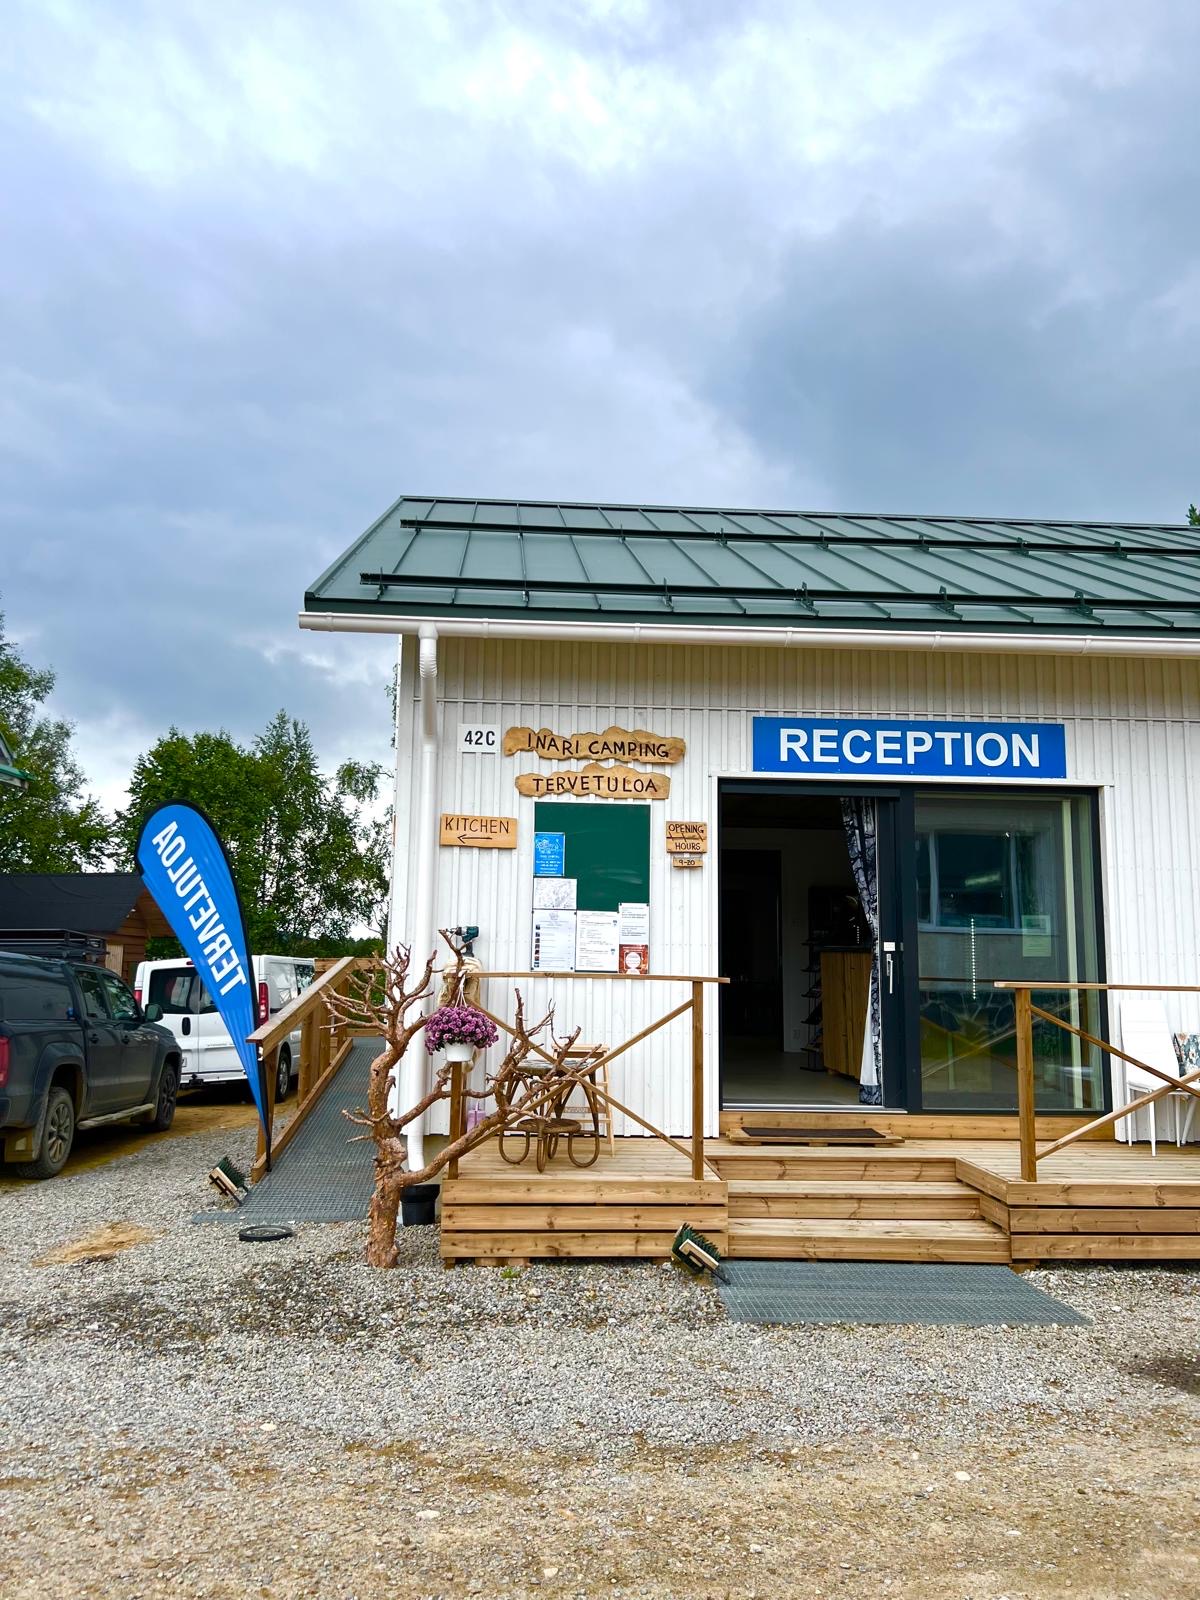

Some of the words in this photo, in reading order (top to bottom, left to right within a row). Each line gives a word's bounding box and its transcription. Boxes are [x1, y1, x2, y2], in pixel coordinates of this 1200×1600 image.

[464, 730, 496, 746] 42C
[527, 732, 580, 755] INARI
[588, 740, 670, 758] CAMPING
[779, 727, 1039, 767] RECEPTION
[532, 775, 658, 793] TERVETULOA
[445, 817, 510, 834] KITCHEN
[668, 823, 704, 834] OPENING
[675, 842, 701, 851] HOURS
